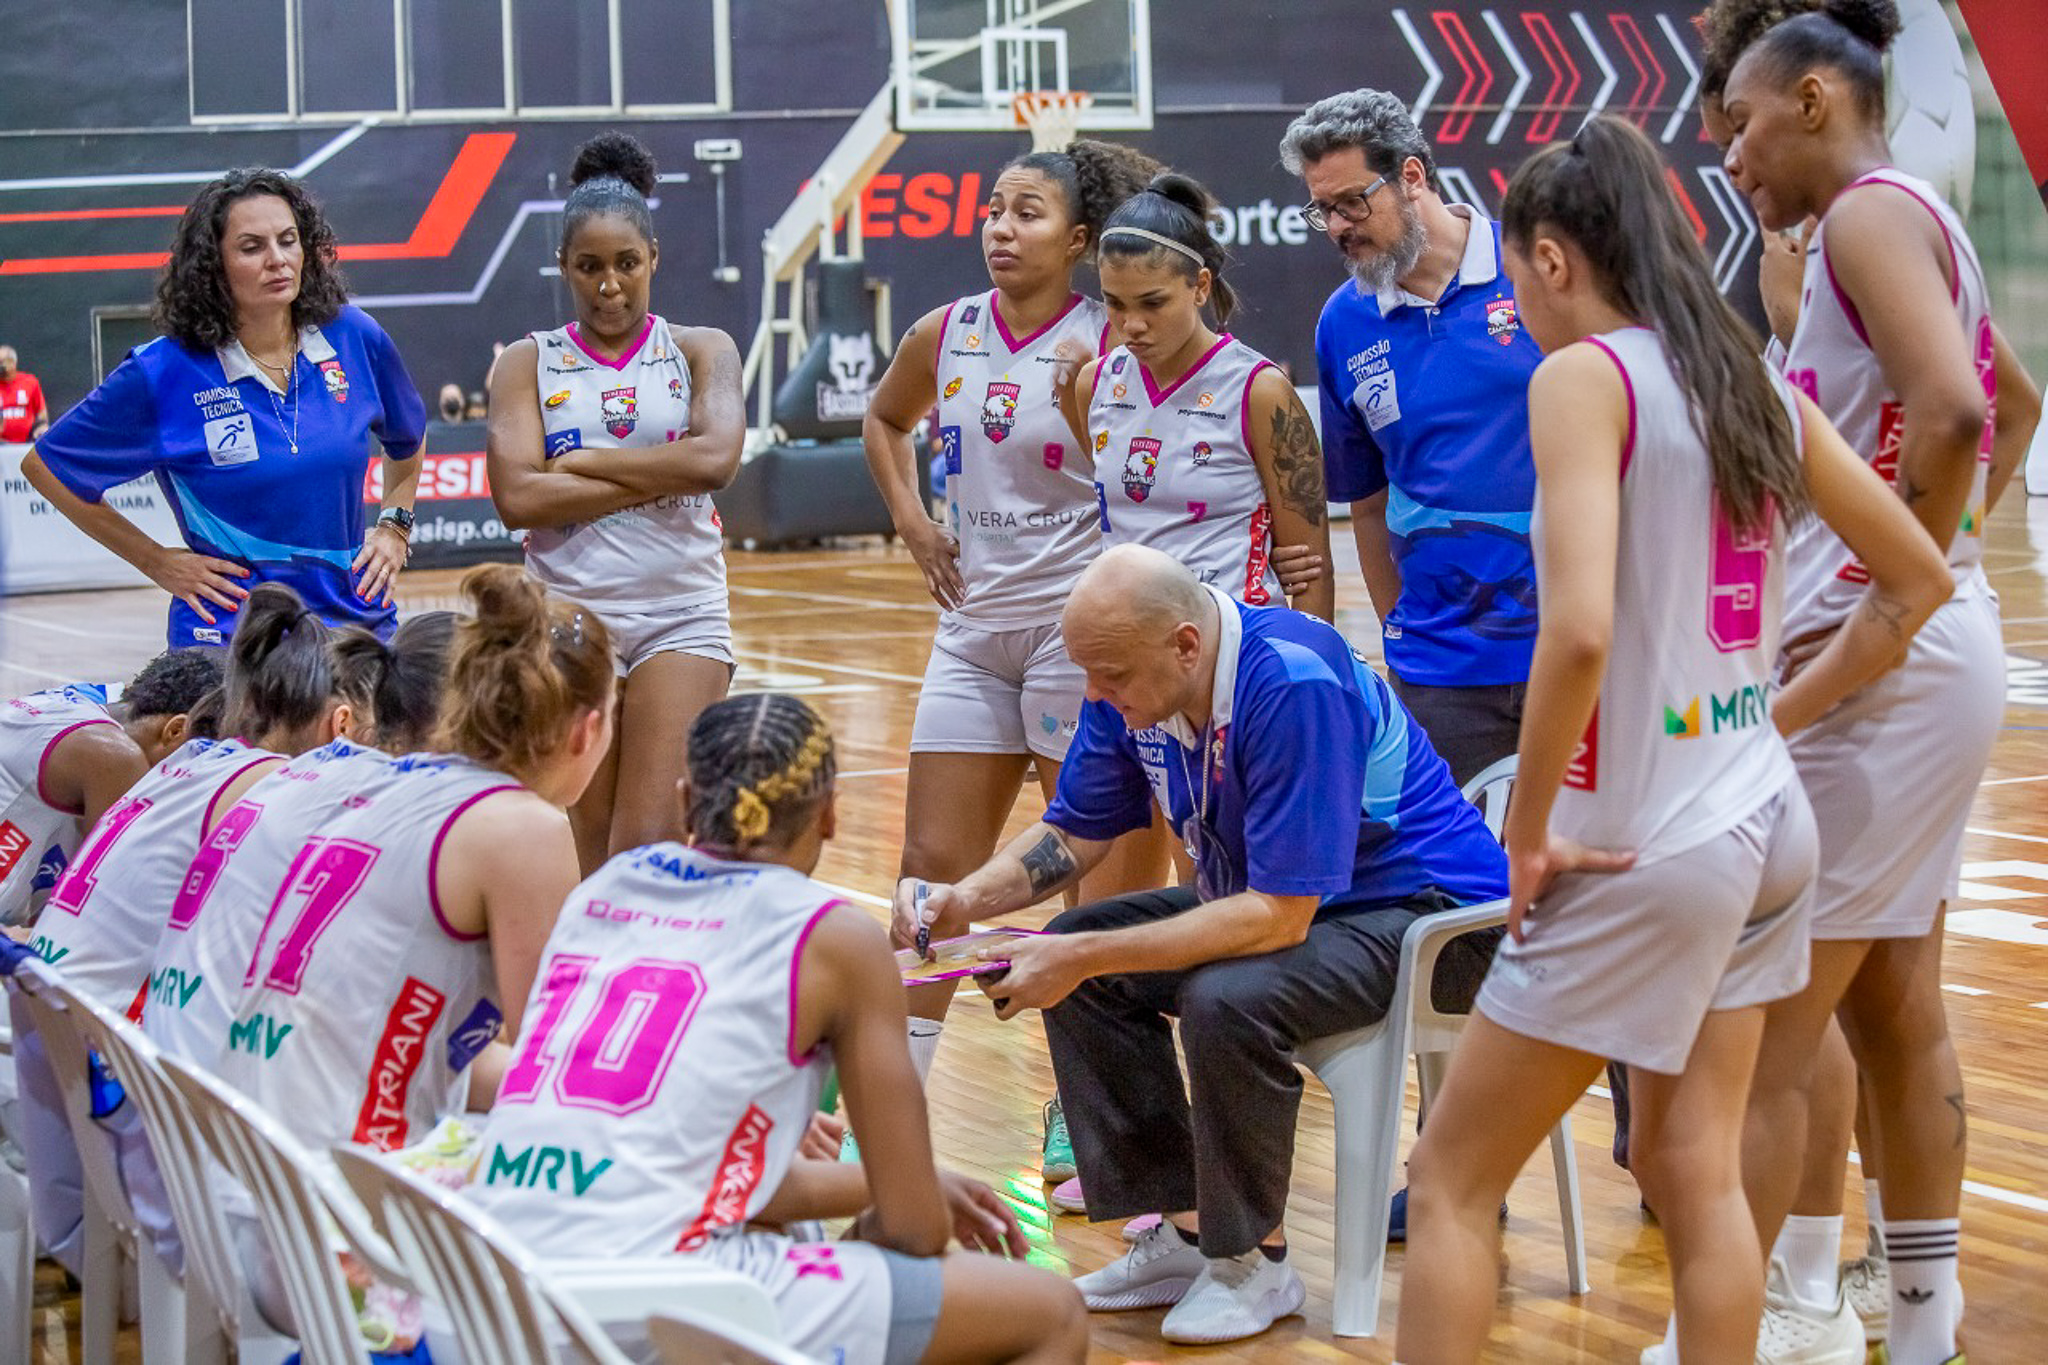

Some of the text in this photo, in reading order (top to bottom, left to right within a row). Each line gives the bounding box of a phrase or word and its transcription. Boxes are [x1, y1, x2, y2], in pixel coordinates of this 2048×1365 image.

[797, 172, 1308, 245] ESI- orte
[1347, 339, 1391, 372] COMISSÃO
[193, 387, 240, 405] COMISSÃO
[201, 400, 244, 419] TÉCNICA
[655, 494, 704, 511] CRUZ
[967, 510, 1087, 528] VERA CRUZ
[1062, 720, 1078, 731] VE
[1711, 684, 1769, 734] MRV
[243, 835, 382, 995] 17
[151, 967, 202, 1009] MRV
[494, 953, 707, 1118] 10
[486, 1143, 614, 1196] MRV
